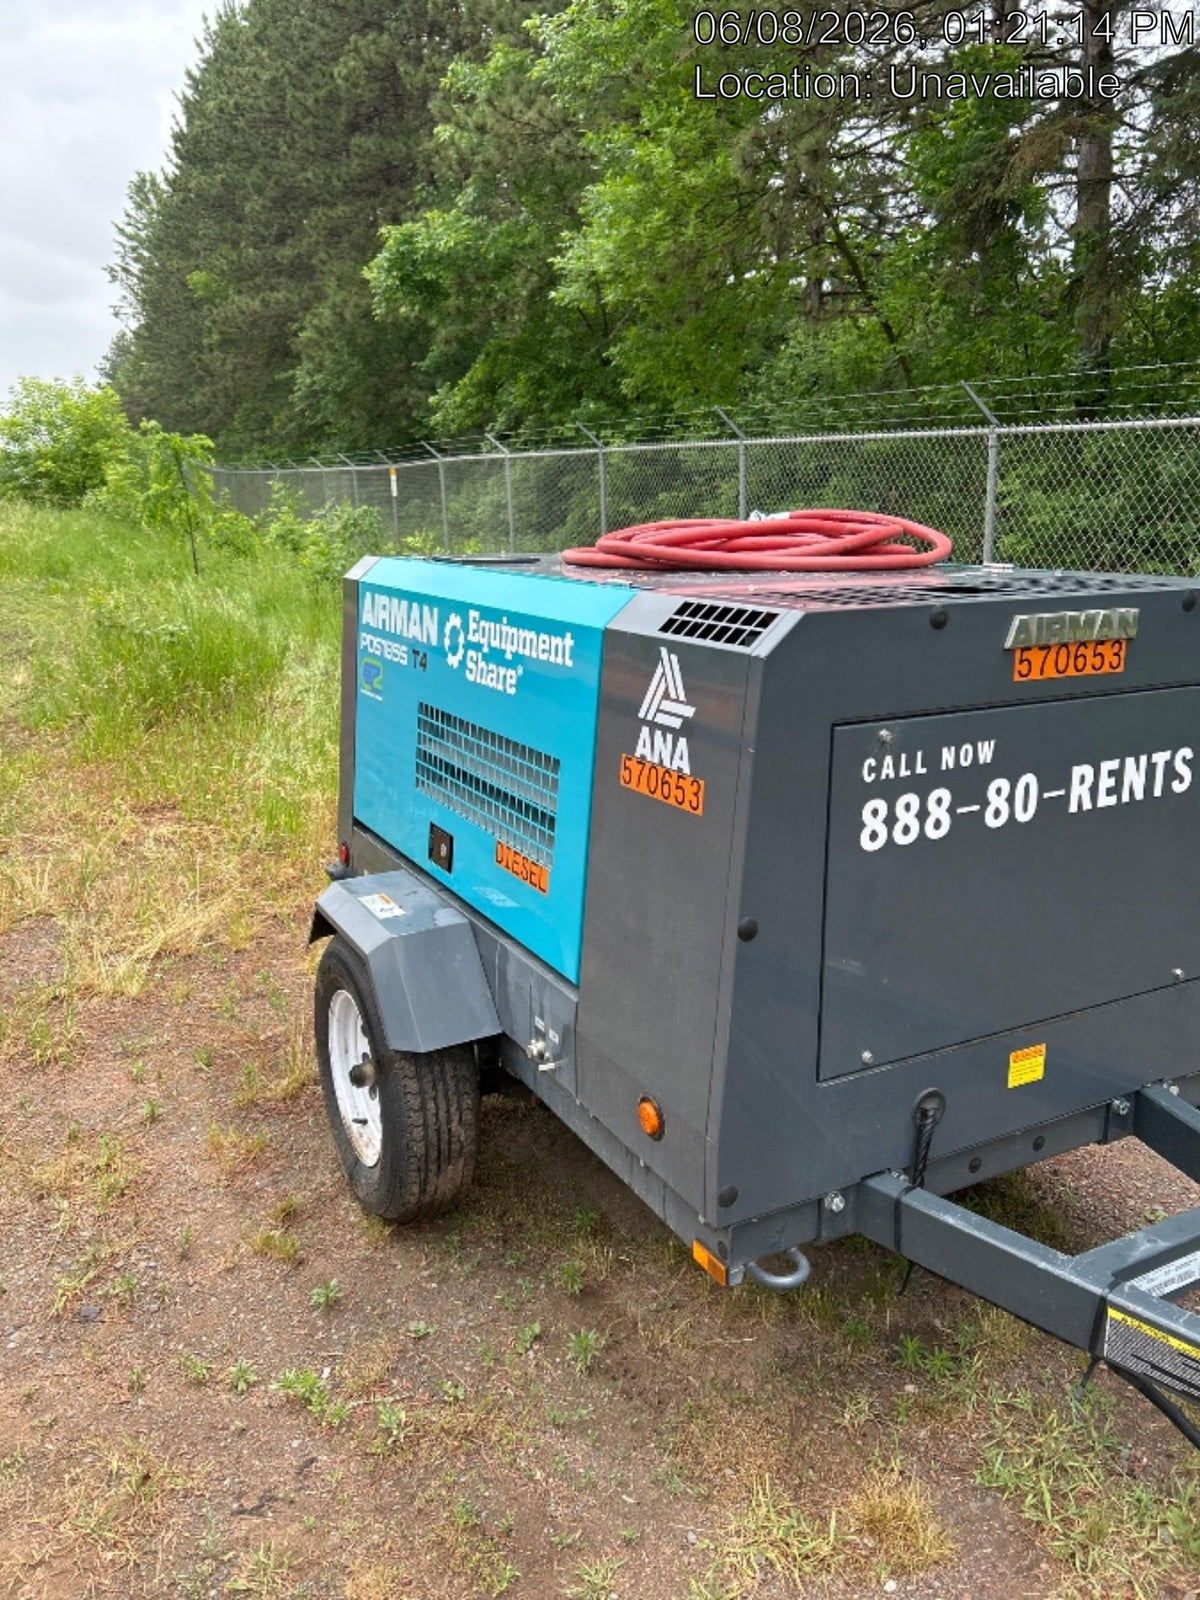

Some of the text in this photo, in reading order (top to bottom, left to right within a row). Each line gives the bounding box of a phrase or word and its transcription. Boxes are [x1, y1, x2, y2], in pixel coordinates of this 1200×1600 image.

[362, 591, 439, 646] AIRMAN
[467, 609, 575, 667] Equipment
[1003, 608, 1140, 650] AIRMAN
[412, 648, 427, 672] T4
[1018, 640, 1123, 678] 570653
[634, 725, 691, 775] ANA
[862, 739, 996, 783] CALL NOW
[621, 757, 702, 811] 570653
[860, 746, 1194, 853] 888-80-RENTS
[495, 840, 547, 893] DIESEL
